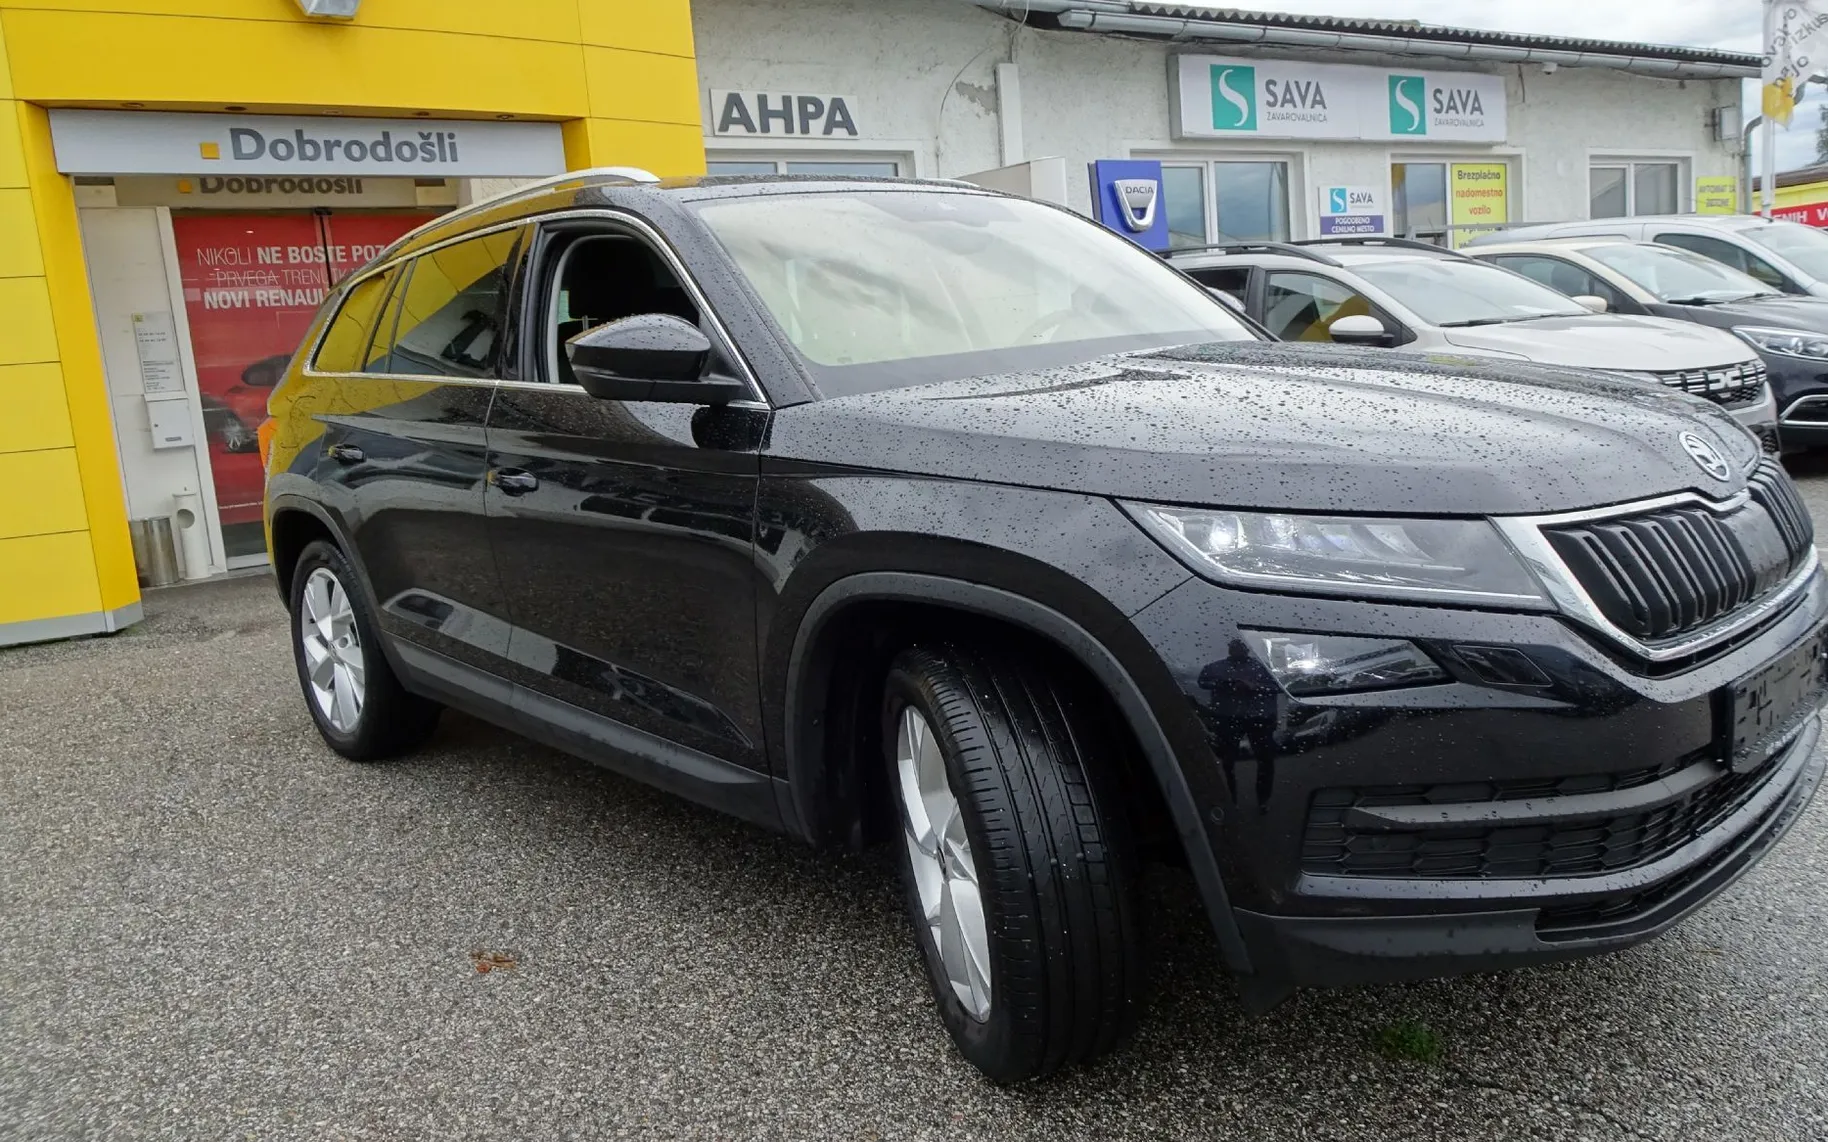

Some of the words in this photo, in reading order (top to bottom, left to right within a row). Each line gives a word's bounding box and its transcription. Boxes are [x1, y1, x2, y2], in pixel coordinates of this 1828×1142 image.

[1265, 79, 1327, 109] SAVA
[1433, 88, 1484, 116] SAVA
[718, 92, 858, 136] AHPA
[1266, 111, 1327, 123] ZAVAROVALNICA
[229, 127, 458, 163] Dobrodošli
[1457, 170, 1501, 182] Brezplačno
[1125, 186, 1154, 194] DACIA
[1349, 192, 1374, 204] SAVA
[1455, 188, 1503, 198] nadomestno
[1468, 205, 1492, 215] vozilo
[197, 247, 252, 266] NIKOLI
[257, 247, 283, 264] NE
[288, 246, 347, 264] BOSTE
[216, 270, 280, 287] PRVEGA
[204, 290, 249, 309] NOVI
